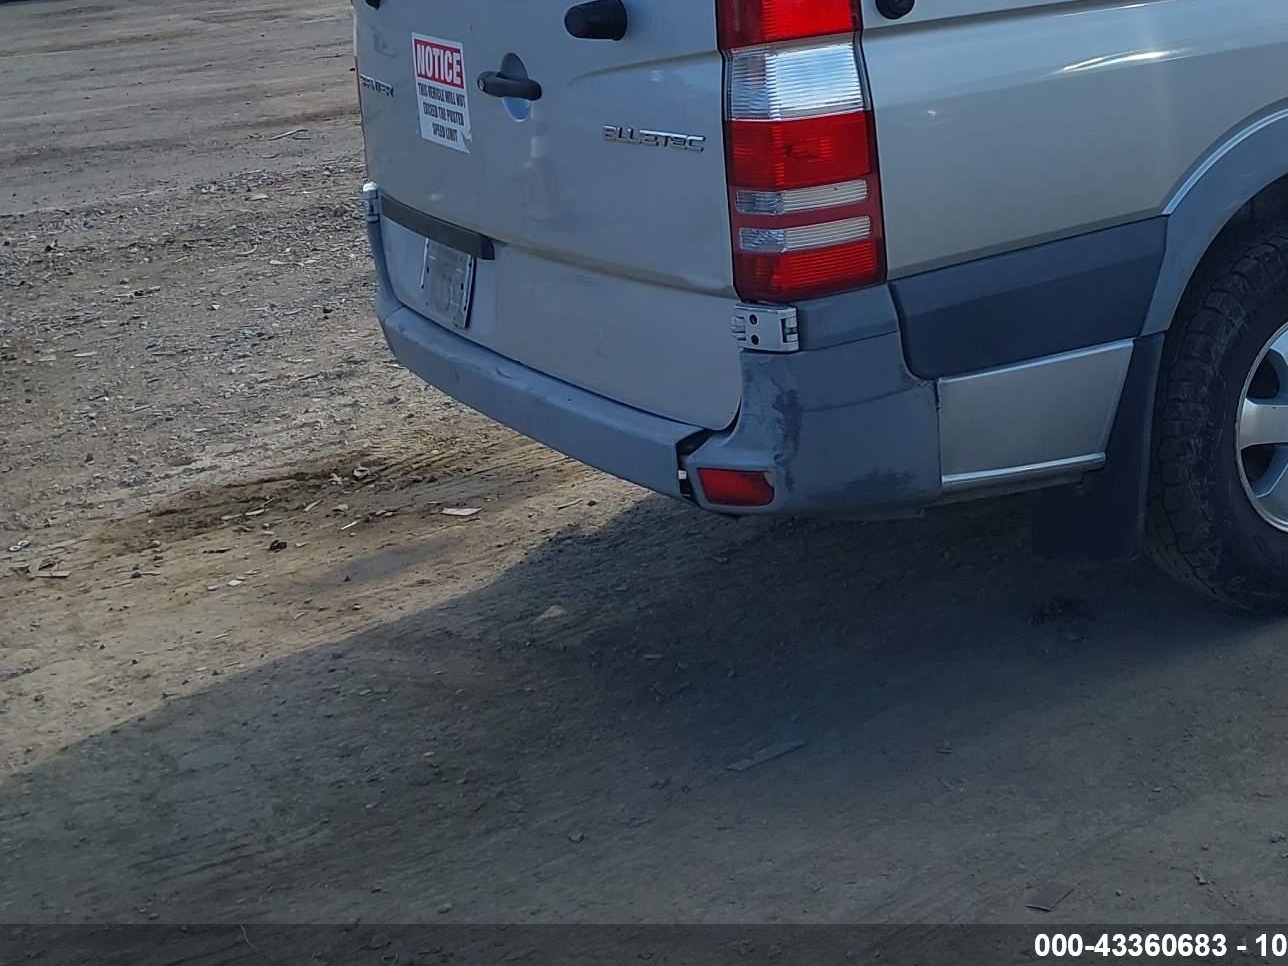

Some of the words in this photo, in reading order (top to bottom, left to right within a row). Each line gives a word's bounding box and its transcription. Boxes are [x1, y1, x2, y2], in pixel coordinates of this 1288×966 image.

[416, 44, 462, 85] NOTICE
[417, 82, 428, 97] THIS
[428, 85, 445, 102] VEHICLE
[444, 90, 456, 105] WILL
[455, 93, 466, 108] NOT
[423, 102, 438, 118] EXCEED
[438, 106, 447, 121] THE
[446, 109, 464, 126] POSTED
[432, 123, 446, 138] SPEED
